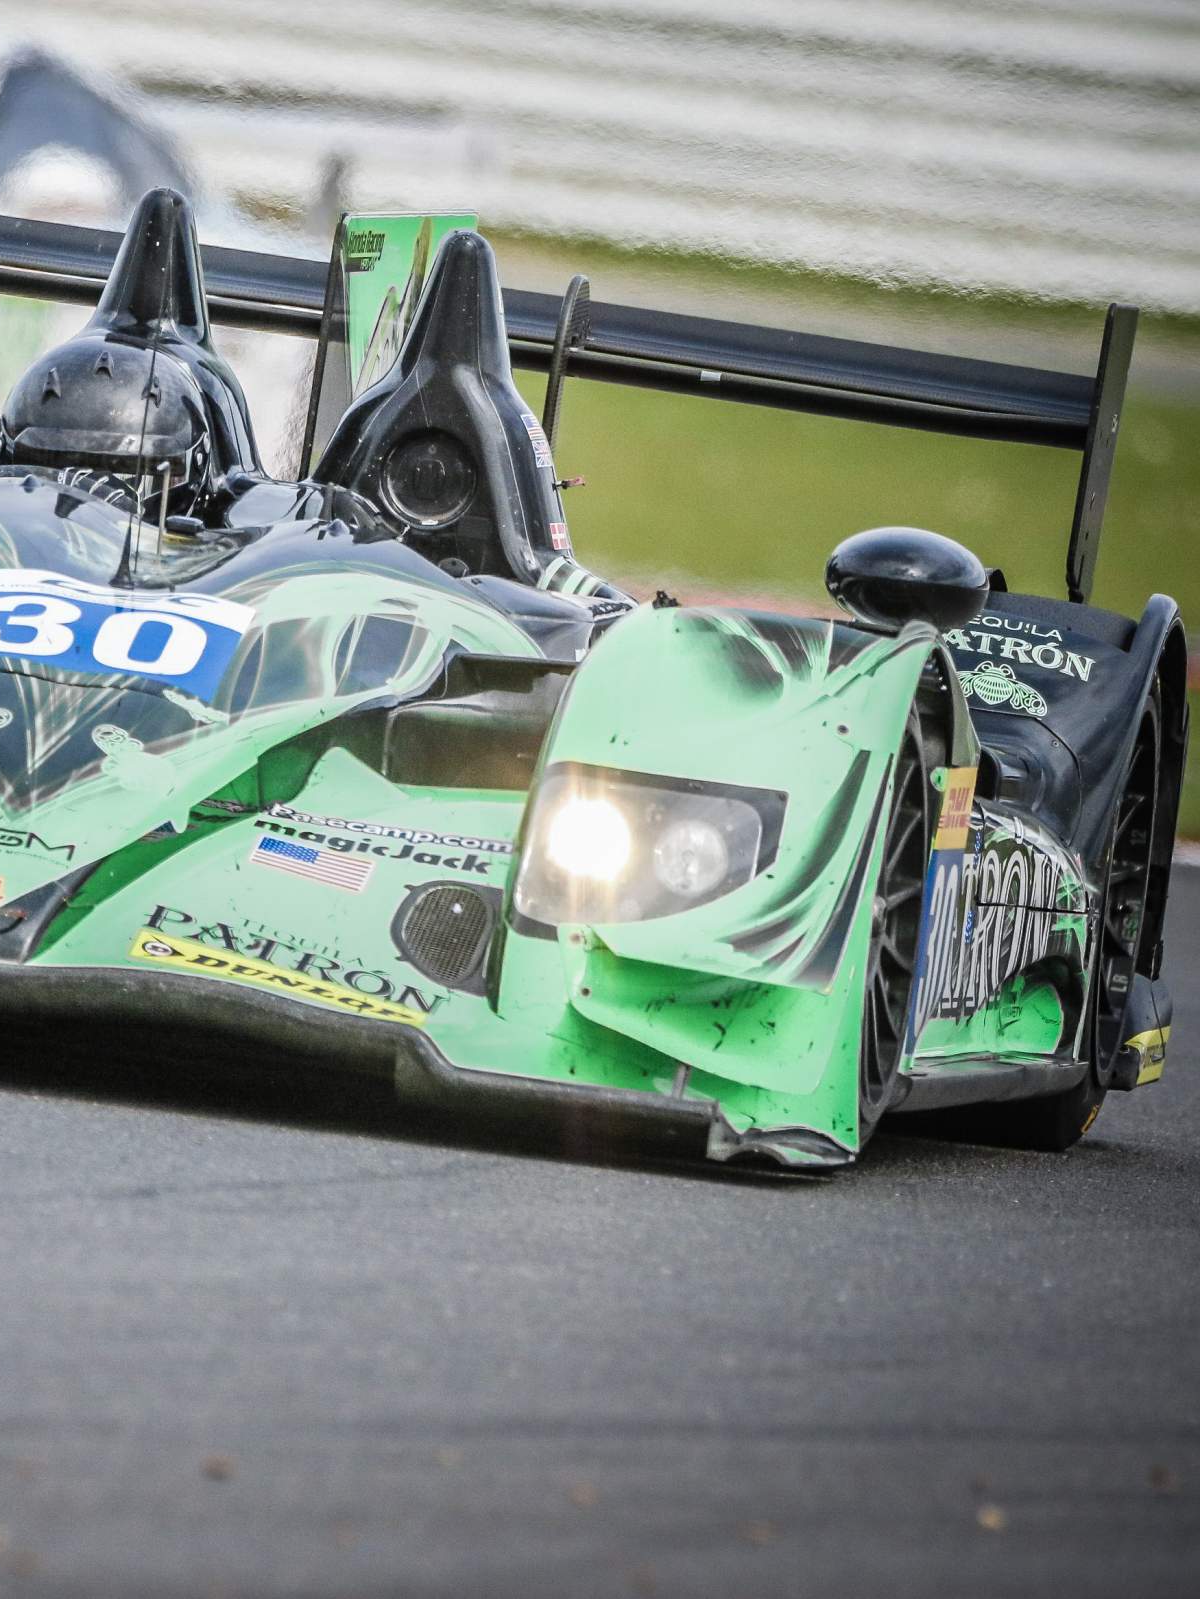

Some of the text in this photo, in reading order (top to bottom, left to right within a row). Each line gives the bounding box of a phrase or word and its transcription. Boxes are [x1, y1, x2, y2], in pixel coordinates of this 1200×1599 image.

[968, 615, 1063, 642] EQUILA
[941, 628, 1097, 682] ATRÓN
[268, 803, 514, 853] Basecamp.com
[143, 904, 450, 1014] PATRÓN
